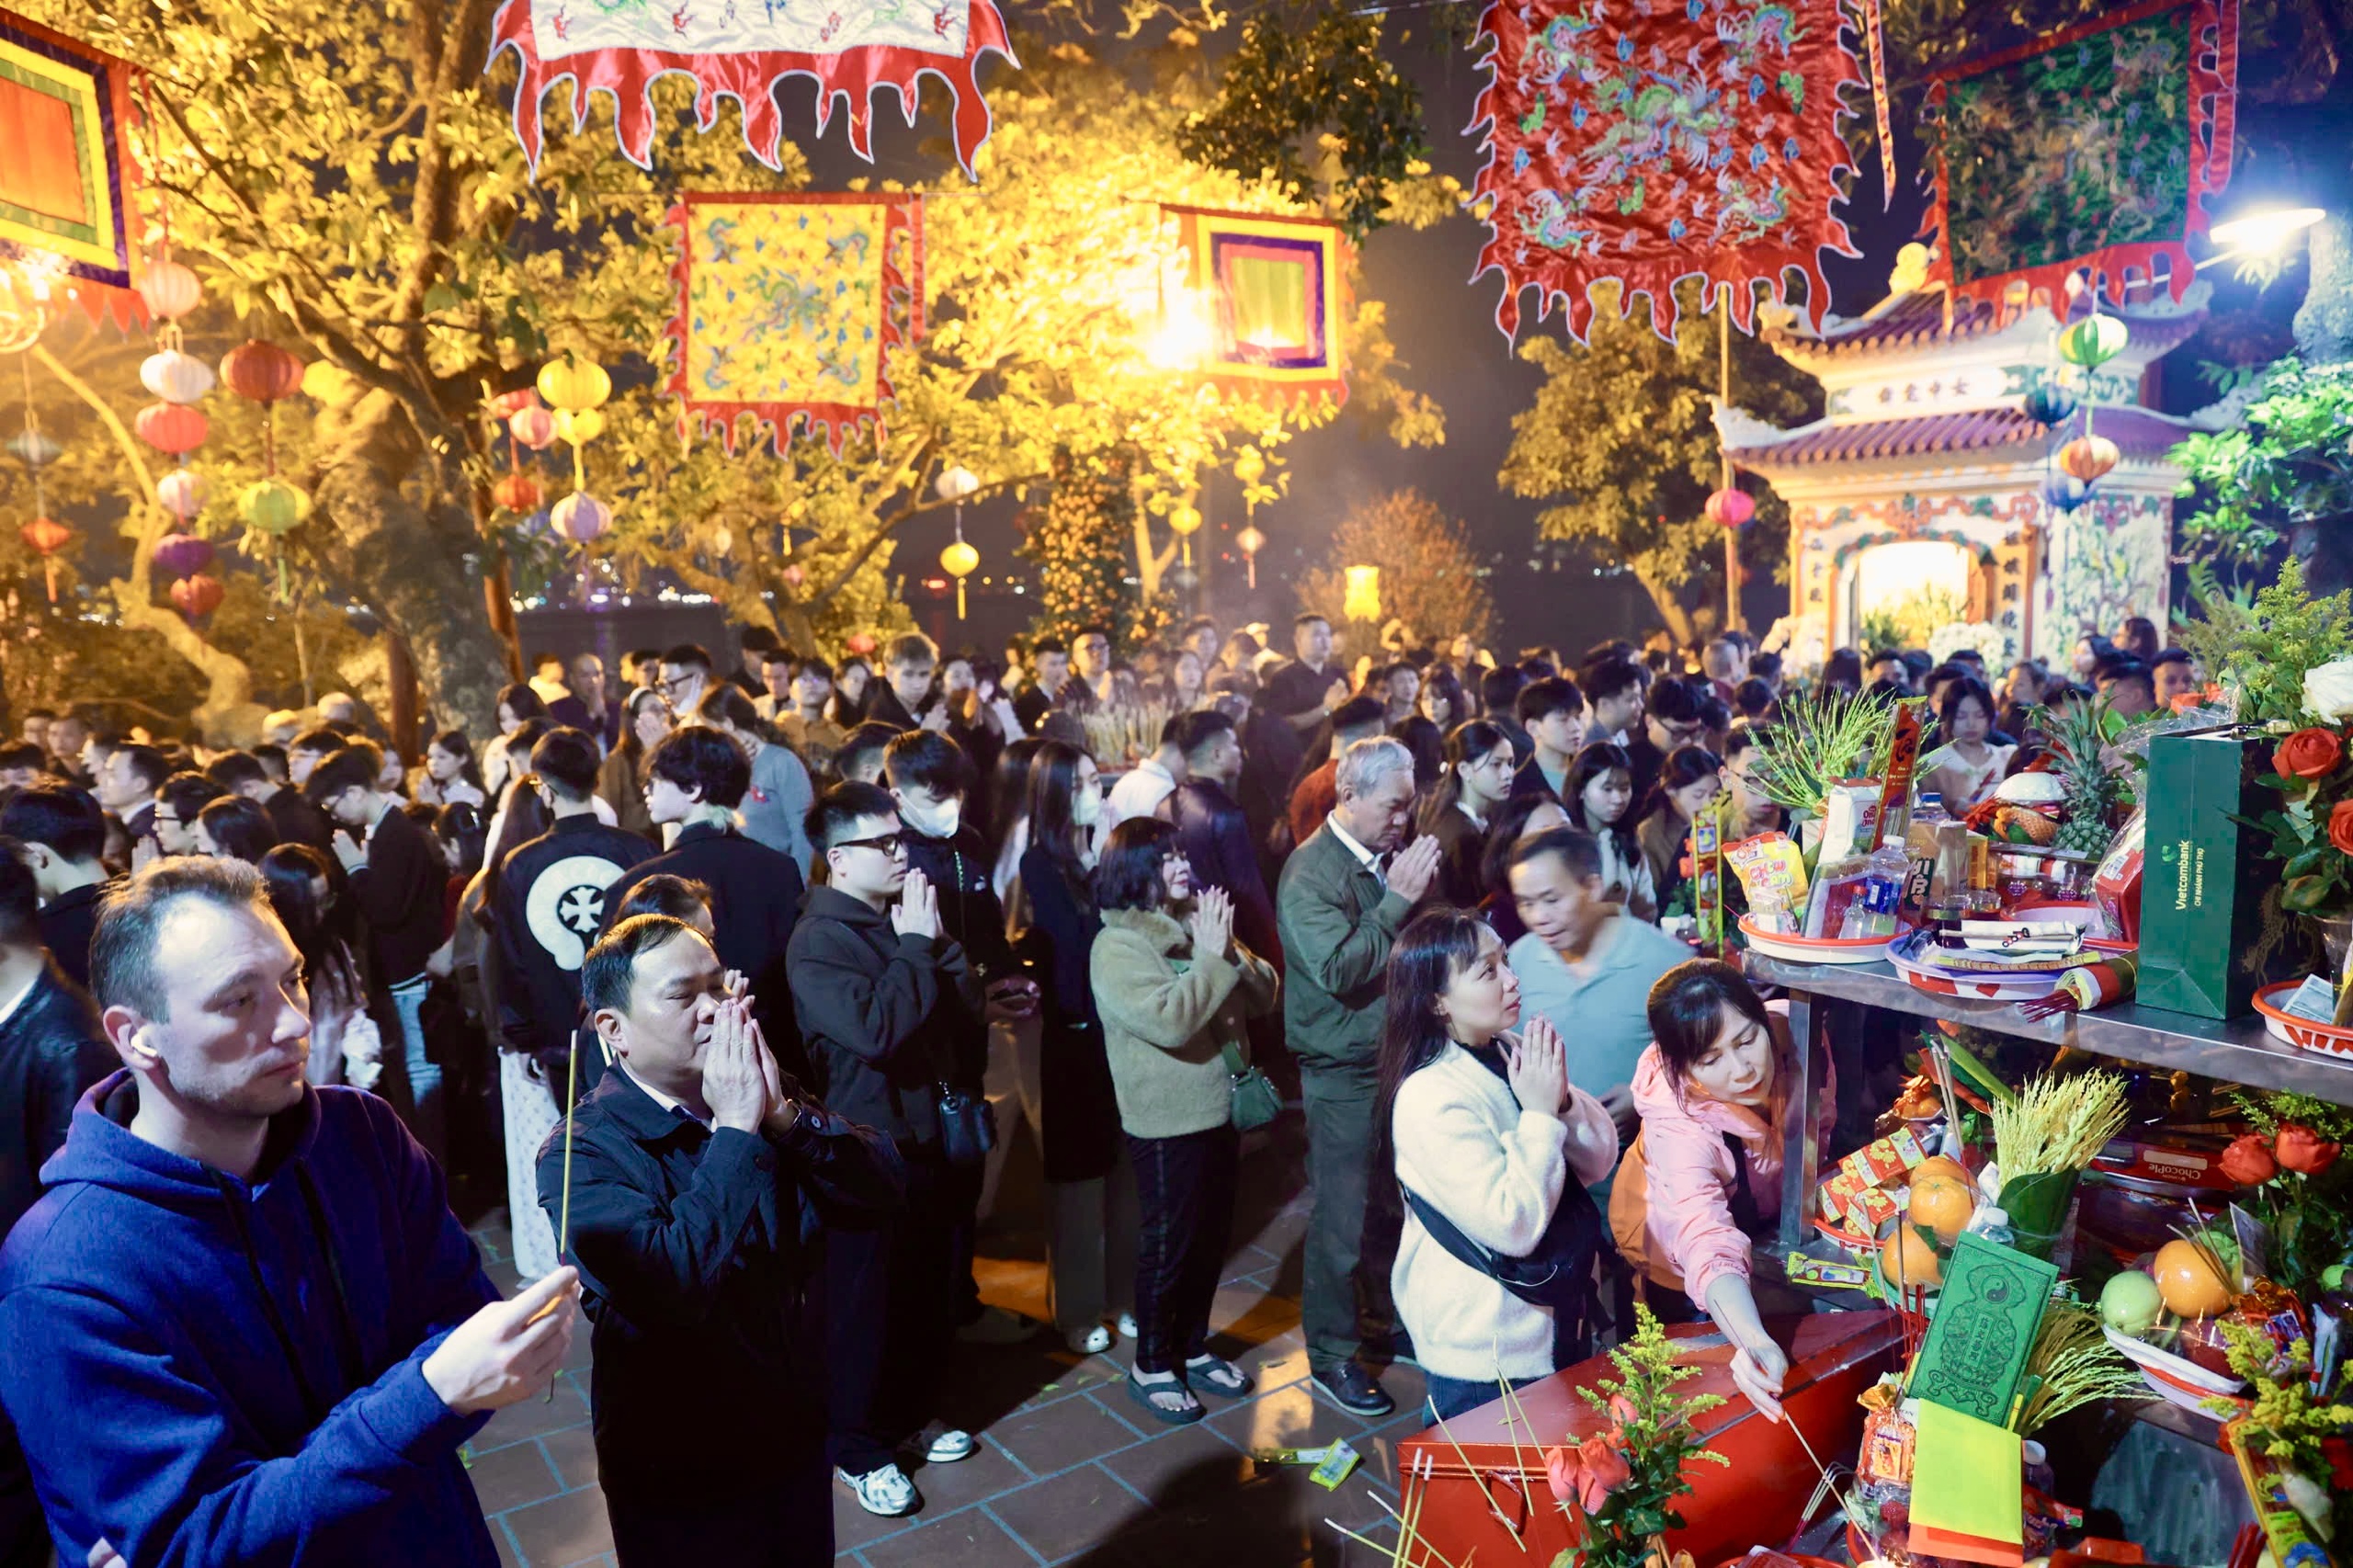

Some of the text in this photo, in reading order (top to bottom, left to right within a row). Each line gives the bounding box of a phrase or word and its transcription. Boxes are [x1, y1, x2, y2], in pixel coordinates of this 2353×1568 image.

[2176, 840, 2189, 910] Vietcombank
[2195, 861, 2203, 874] PHÚ
[2195, 874, 2203, 896] NHÁNH
